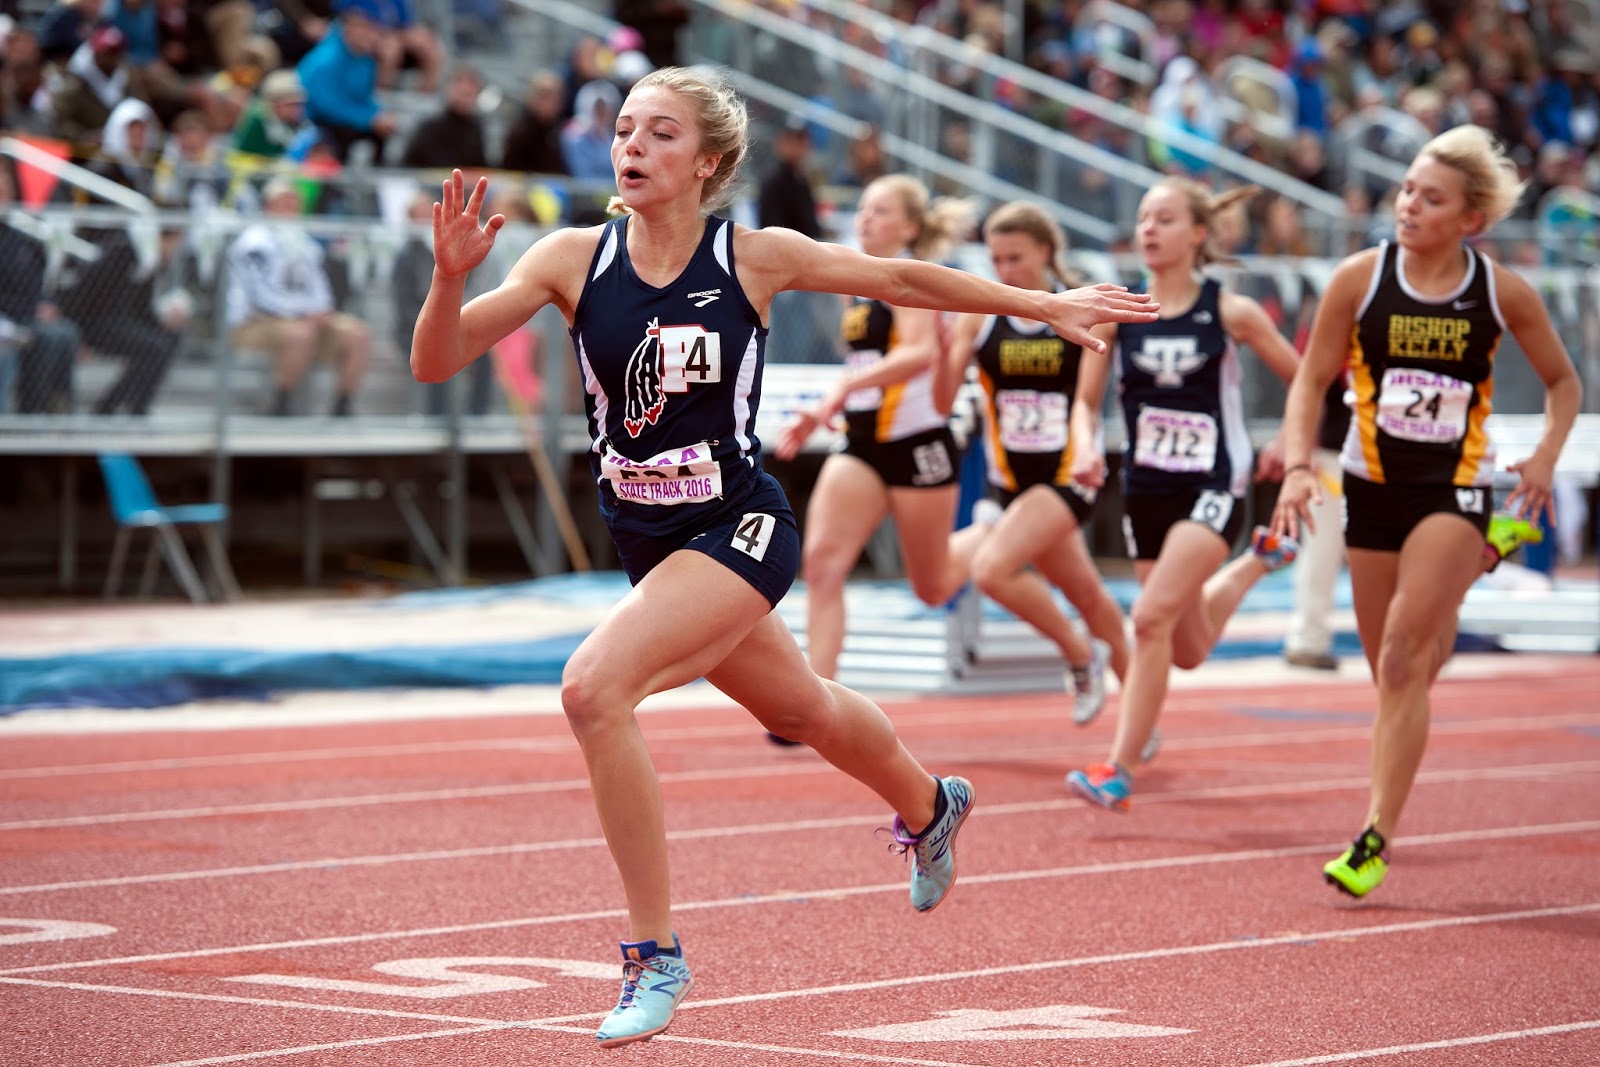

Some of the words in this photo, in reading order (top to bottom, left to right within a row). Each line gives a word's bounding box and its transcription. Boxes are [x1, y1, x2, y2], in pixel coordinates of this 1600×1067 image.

[687, 288, 722, 299] BROOKS
[1388, 313, 1471, 340] BISHOP
[685, 336, 711, 380] 4
[1388, 334, 1469, 362] KELLY
[1404, 389, 1442, 421] 24
[1152, 425, 1201, 457] 712
[619, 482, 647, 499] STATE
[649, 480, 684, 499] TRACK
[684, 477, 712, 498] 2016
[1203, 501, 1221, 522] 6
[735, 515, 764, 553] 4
